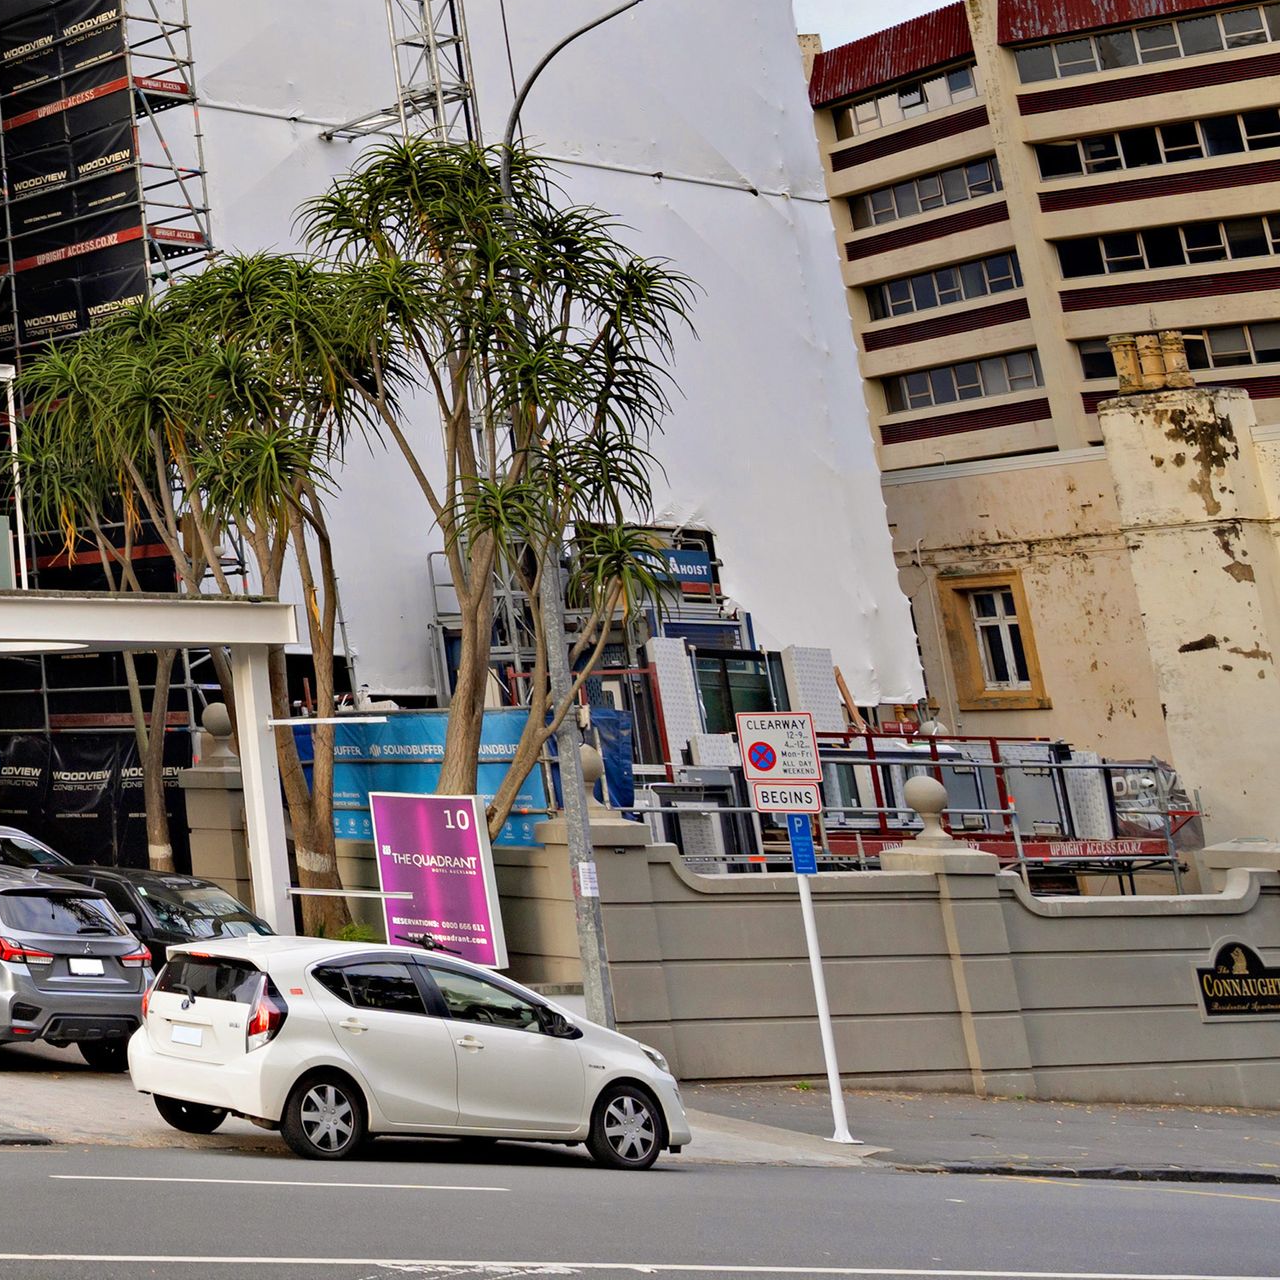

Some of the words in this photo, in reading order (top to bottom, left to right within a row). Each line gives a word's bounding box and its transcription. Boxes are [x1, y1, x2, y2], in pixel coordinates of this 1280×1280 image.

[63, 9, 117, 37] WOODVIEW
[4, 35, 53, 59] WOODVIEW
[37, 99, 67, 118] UPRIGHT
[68, 90, 95, 108] ACCESS
[78, 149, 130, 173] WOODVIEW
[14, 171, 67, 191] WOODVIEW
[37, 249, 66, 265] UPRIGHT
[67, 233, 118, 256] ACCESS.CO.NZ
[24, 310, 77, 328] WOODVIEW
[26, 323, 78, 338] CONSTRUCTION
[746, 719, 806, 730] CLEARWAY
[383, 744, 445, 756] SOUNDBUFFER
[781, 750, 813, 758] Mon-Fri
[52, 770, 112, 781] WOODVIEW
[783, 767, 815, 775] WEEKEND
[52, 782, 108, 791] CONSTRUCTION
[761, 790, 813, 804] BEGINS
[443, 809, 470, 830] 10
[793, 817, 803, 833] P
[1049, 842, 1085, 856] UPRIGHT
[1087, 840, 1143, 855] ACCESS.CO.NZ
[392, 852, 412, 865] THE
[413, 854, 477, 870] QUADRANT
[392, 916, 439, 928] RESERVATIONS:
[442, 922, 458, 930] 0800
[459, 923, 471, 931] 666
[473, 924, 485, 932] 611
[1217, 966, 1230, 974] The
[1212, 1001, 1250, 1010] Residential
